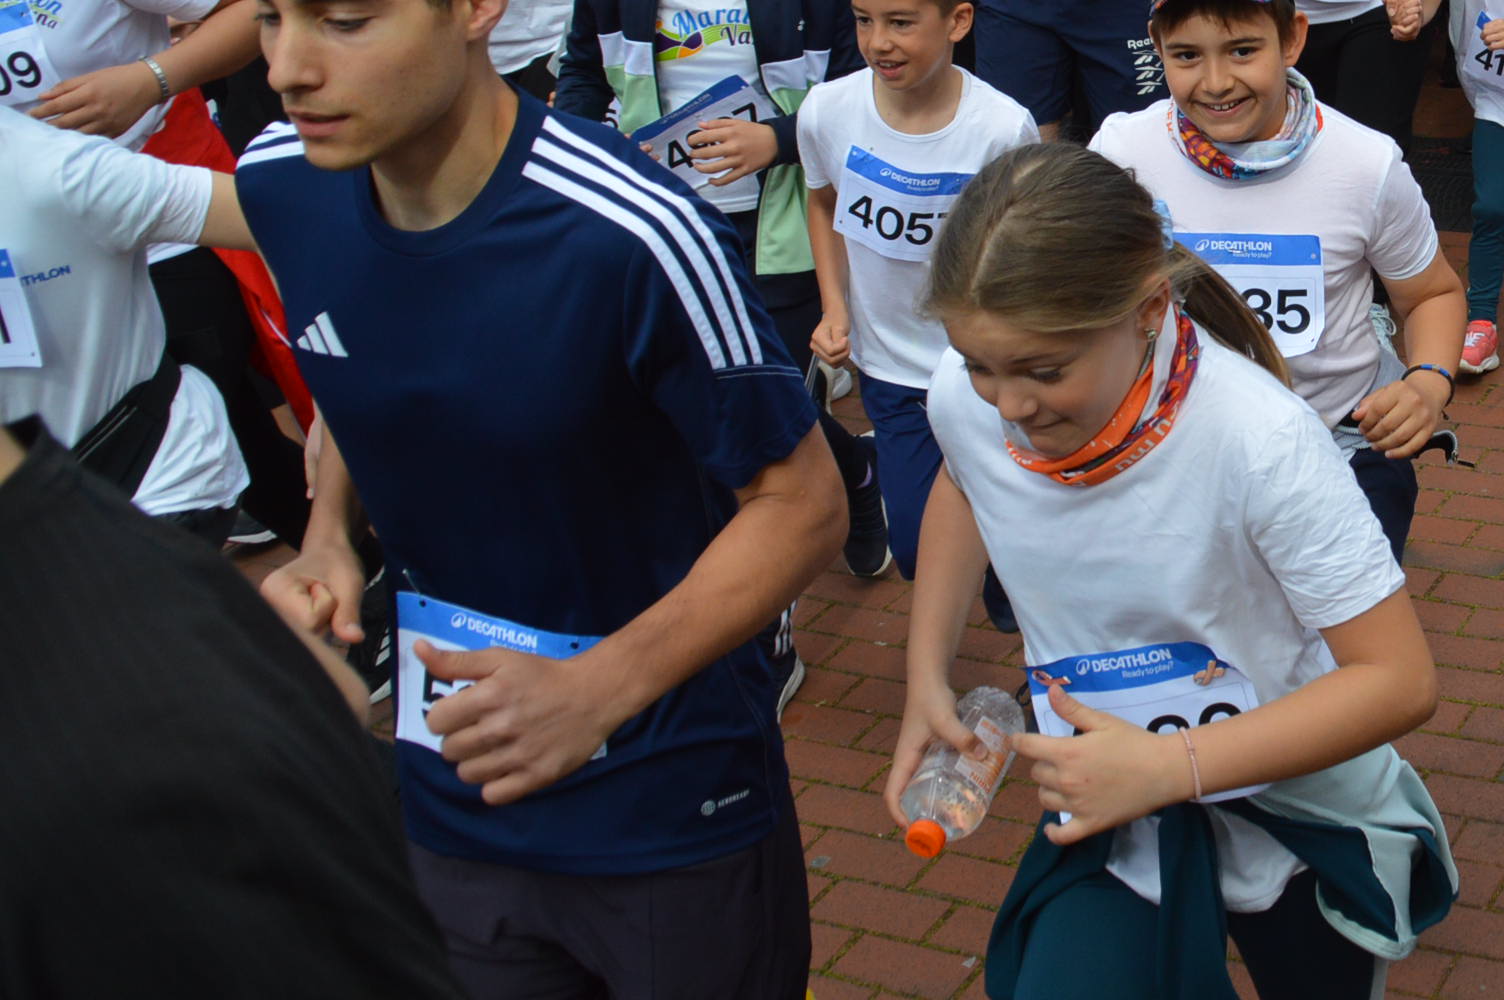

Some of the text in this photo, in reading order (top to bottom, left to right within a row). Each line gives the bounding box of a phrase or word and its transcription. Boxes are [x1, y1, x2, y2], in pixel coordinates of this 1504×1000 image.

[672, 8, 751, 39] Mara
[890, 173, 941, 186] DECATHLON
[848, 194, 949, 246] 405
[1210, 240, 1272, 252] DECATHLON
[466, 617, 538, 649] DECATHLON
[1091, 648, 1173, 673] DECATHLON
[1122, 660, 1174, 680] Ready to play?
